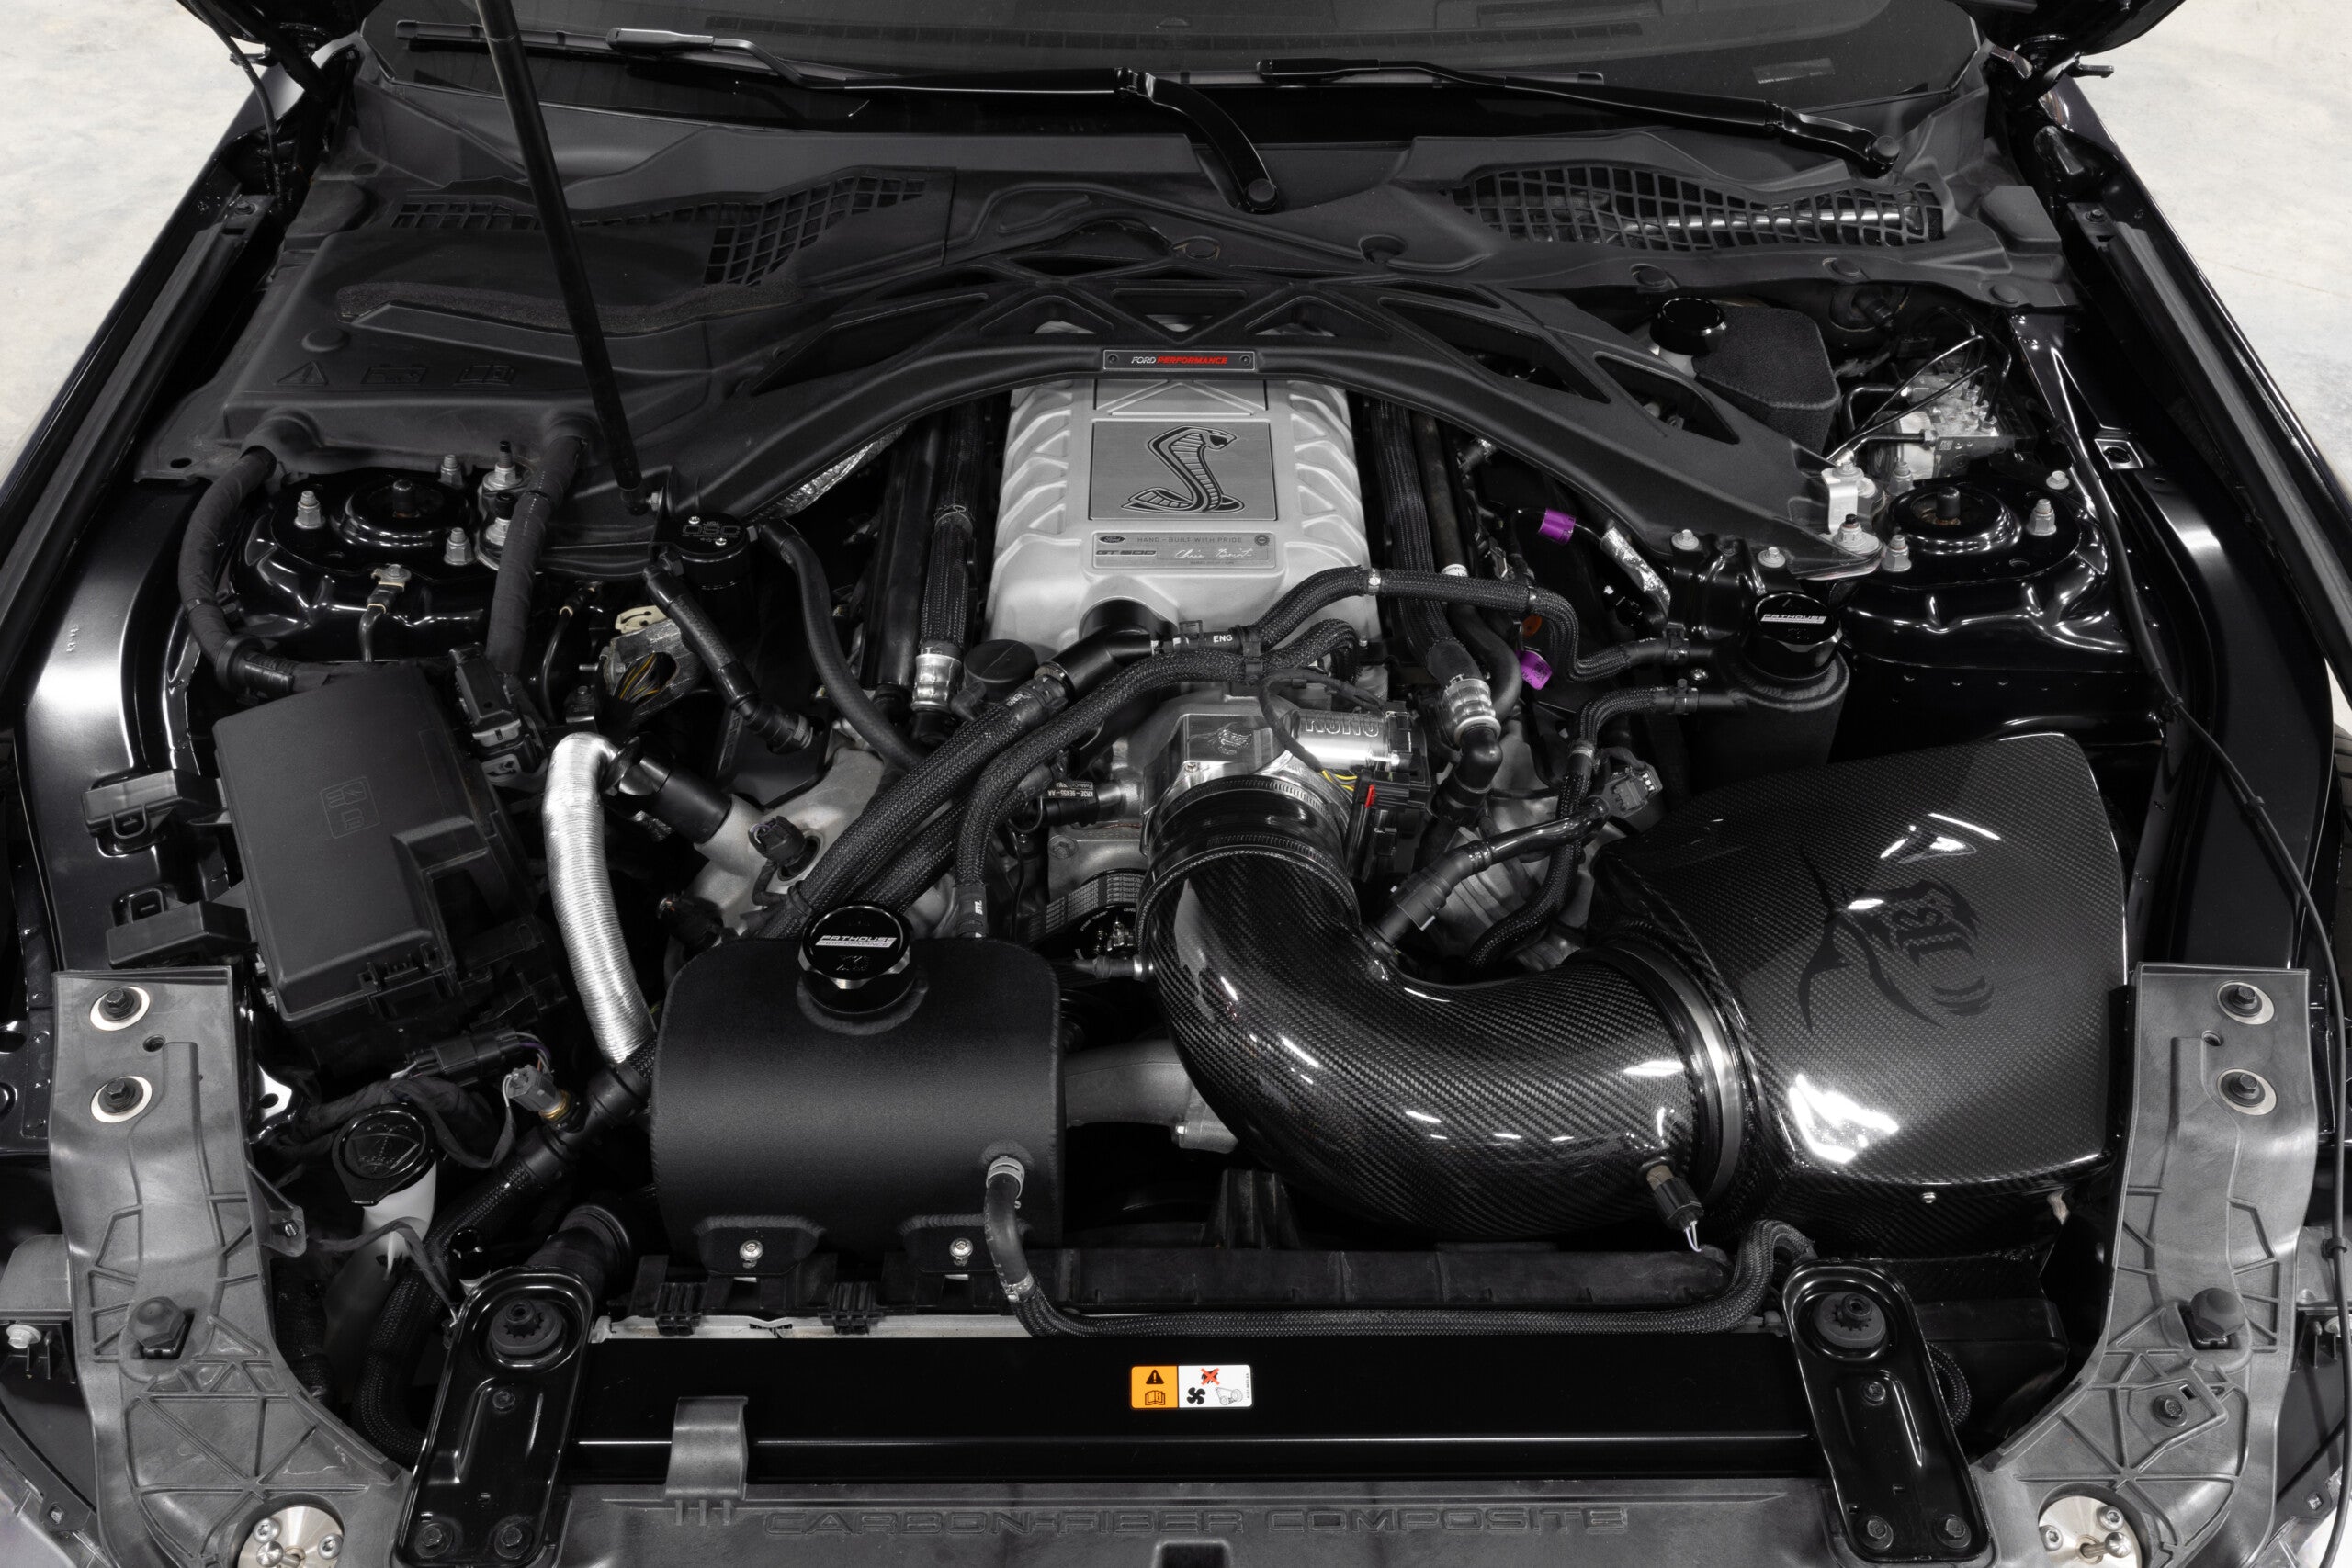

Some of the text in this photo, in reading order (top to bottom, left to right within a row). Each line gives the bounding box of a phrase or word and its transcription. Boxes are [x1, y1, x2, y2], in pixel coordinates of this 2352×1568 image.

[1158, 356, 1227, 365] PERFORMANCE
[1213, 635, 1232, 643] ENG
[765, 1506, 1628, 1536] CARBON-FIBER COMPOSITE
